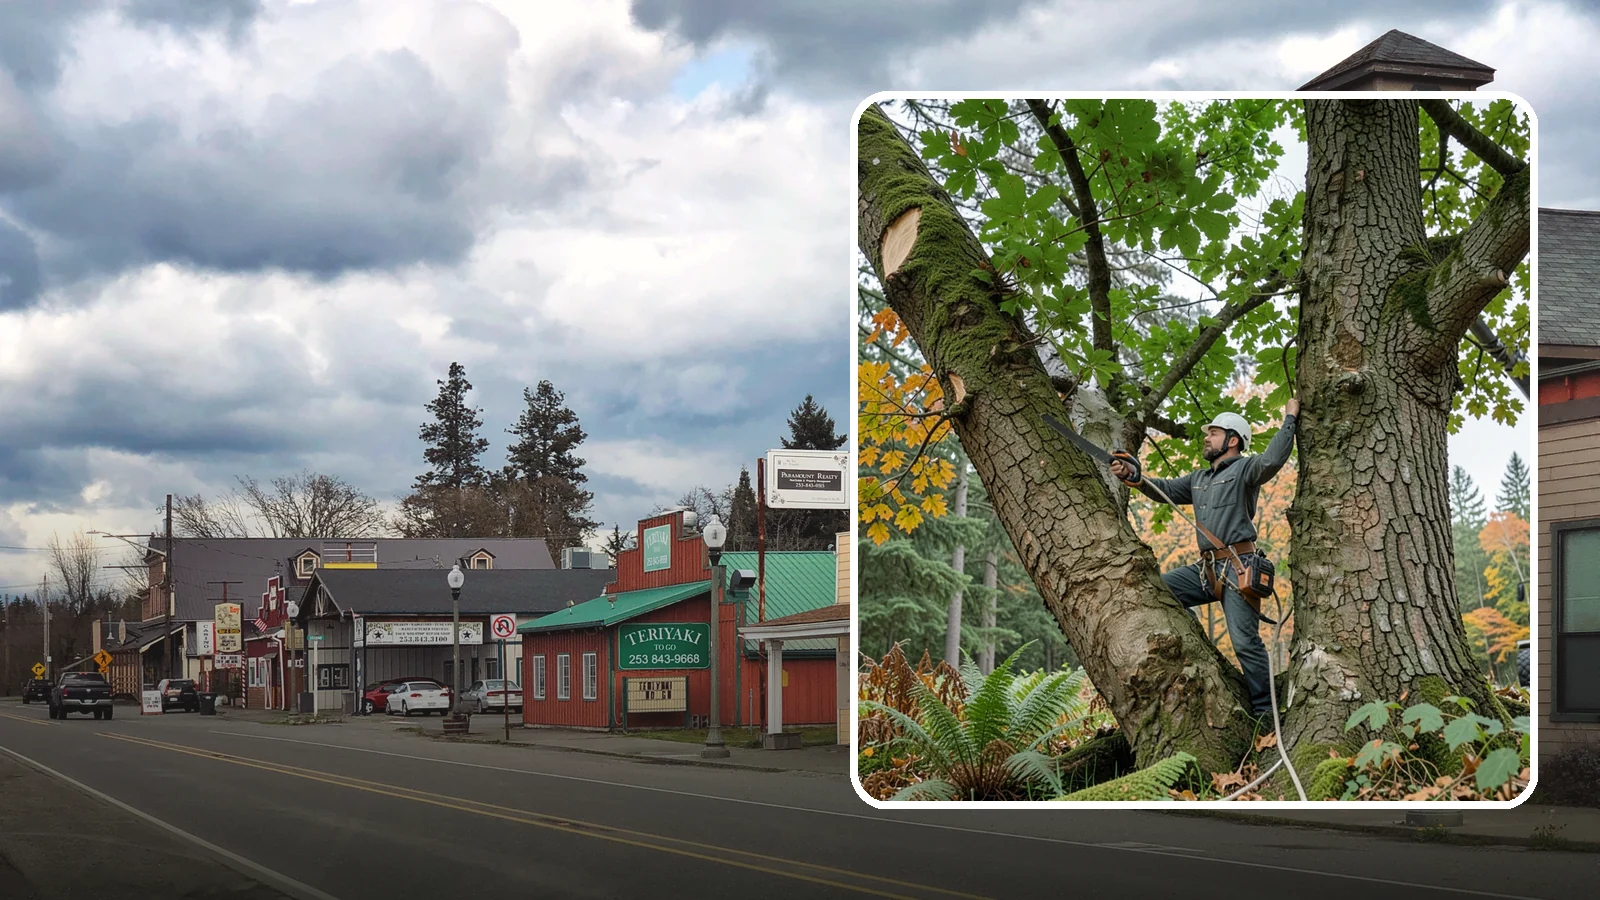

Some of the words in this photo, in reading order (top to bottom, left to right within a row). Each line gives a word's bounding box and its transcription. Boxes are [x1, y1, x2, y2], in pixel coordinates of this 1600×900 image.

[781, 471, 814, 479] PARAMOUNT
[625, 627, 702, 646] TERIYAKI
[653, 643, 664, 651] TO
[665, 643, 676, 651] GO
[628, 654, 648, 664] 253
[651, 653, 700, 664] 843-9668
[639, 681, 672, 690] TERIYAKI
